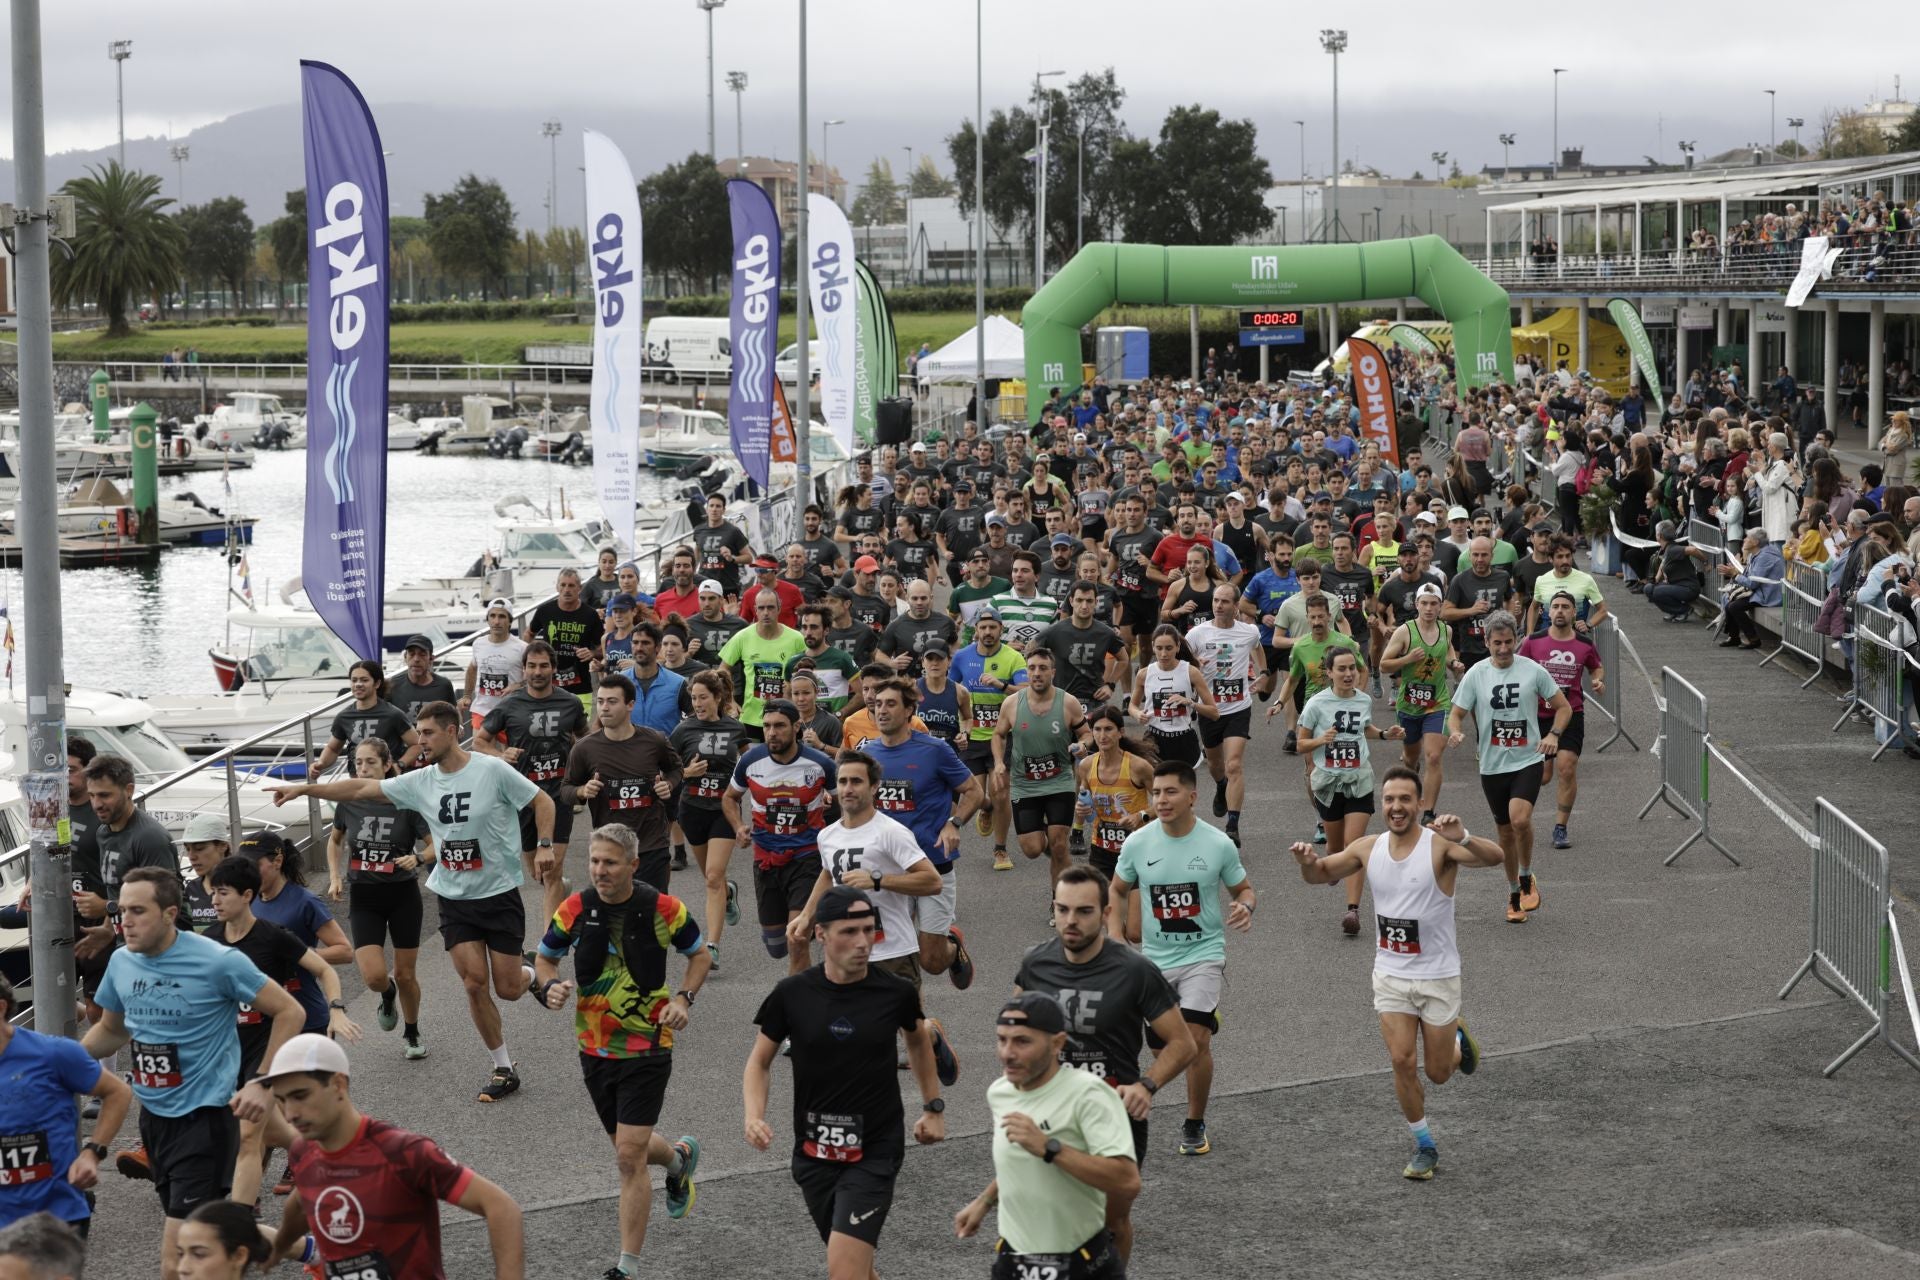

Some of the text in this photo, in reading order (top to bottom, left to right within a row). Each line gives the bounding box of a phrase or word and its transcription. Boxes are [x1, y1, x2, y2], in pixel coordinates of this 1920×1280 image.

[1254, 312, 1296, 325] 0:00:20
[98, 385, 106, 396] B
[1359, 355, 1391, 453] BAHCO
[134, 425, 152, 448] C
[707, 556, 718, 564] 66
[1122, 574, 1139, 585] 268
[1337, 594, 1356, 603] 215
[863, 614, 875, 623] 35
[1194, 616, 1207, 627] 98
[560, 632, 579, 643] ELZO
[1549, 649, 1576, 664] 20
[483, 679, 504, 689] 364
[758, 684, 780, 694] 155
[1218, 685, 1240, 695] 243
[1409, 688, 1432, 700] 389
[976, 710, 999, 721] 338
[1051, 720, 1060, 734] S
[1496, 727, 1522, 739] 279
[1330, 748, 1356, 760] 113
[533, 758, 559, 773] 347
[1030, 761, 1055, 773] 233
[700, 777, 719, 790] 95
[619, 785, 641, 799] 62
[878, 787, 906, 801] 221
[776, 813, 797, 826] 57
[1099, 828, 1126, 841] 188
[359, 850, 389, 862] 157
[444, 848, 473, 862] 387
[1158, 891, 1193, 909] 130
[1386, 926, 1407, 942] 23
[128, 1007, 182, 1017] ZUBIETAKO
[136, 1053, 171, 1074] 133
[1016, 1263, 1059, 1280] 342
